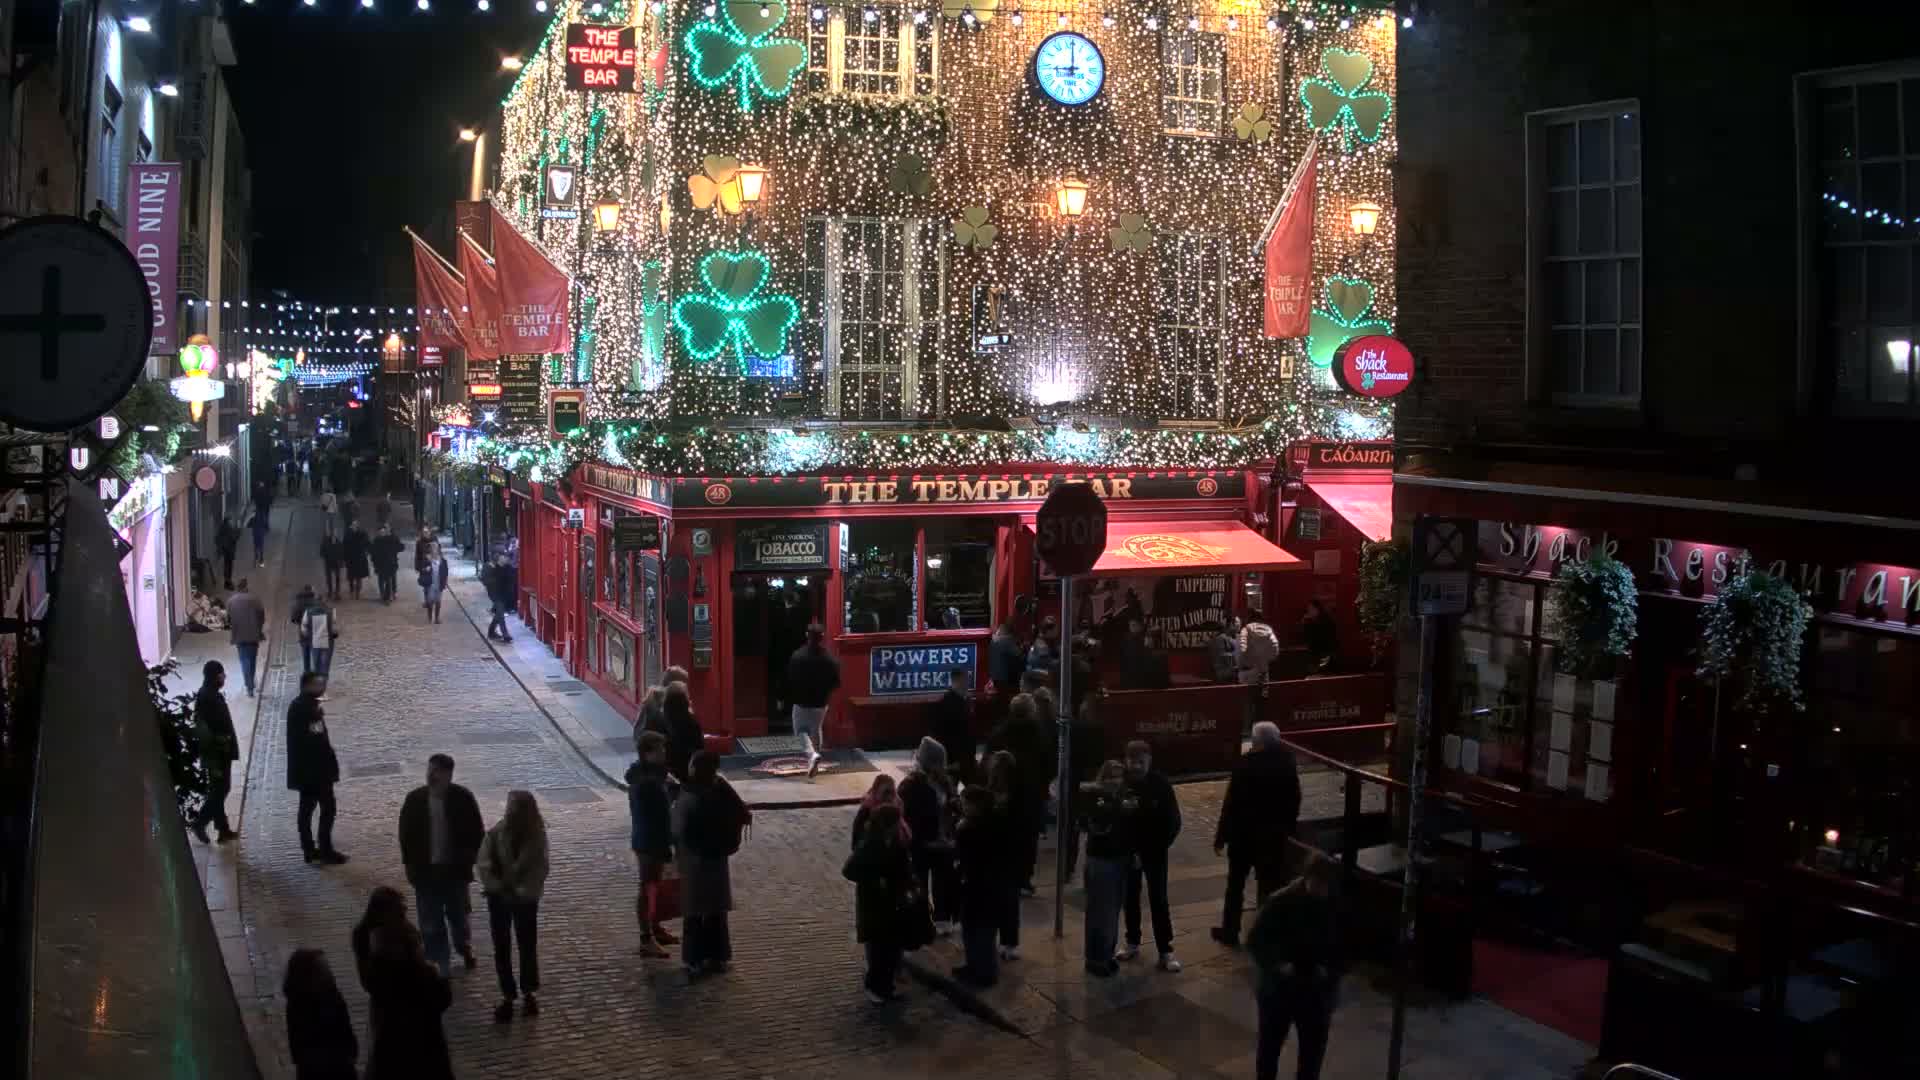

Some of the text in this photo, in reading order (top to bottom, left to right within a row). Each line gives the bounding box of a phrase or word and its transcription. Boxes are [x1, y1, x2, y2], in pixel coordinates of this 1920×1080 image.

[584, 29, 619, 46] THE
[569, 47, 633, 65] TEMPLE
[584, 69, 617, 85] BAR
[138, 172, 170, 232] NINE
[520, 304, 545, 314] THE
[503, 313, 563, 326] TEMPLE
[518, 326, 550, 338] BAR
[1355, 349, 1388, 375] Shack
[1366, 349, 1377, 358] The
[1372, 371, 1409, 380] Restaurant
[594, 468, 653, 499] THE TEMPLE BAR
[823, 478, 1132, 503] THE TEMPLE AR
[1199, 480, 1213, 494] 48
[709, 487, 726, 499] 48
[1041, 514, 1104, 548] STOP
[753, 539, 816, 560] TOBACCO
[1499, 520, 1620, 568] Shack
[1175, 578, 1225, 593] EMPEROR
[1211, 592, 1224, 607] OF
[880, 648, 969, 666] POWER'S
[874, 671, 974, 688] WHISK
